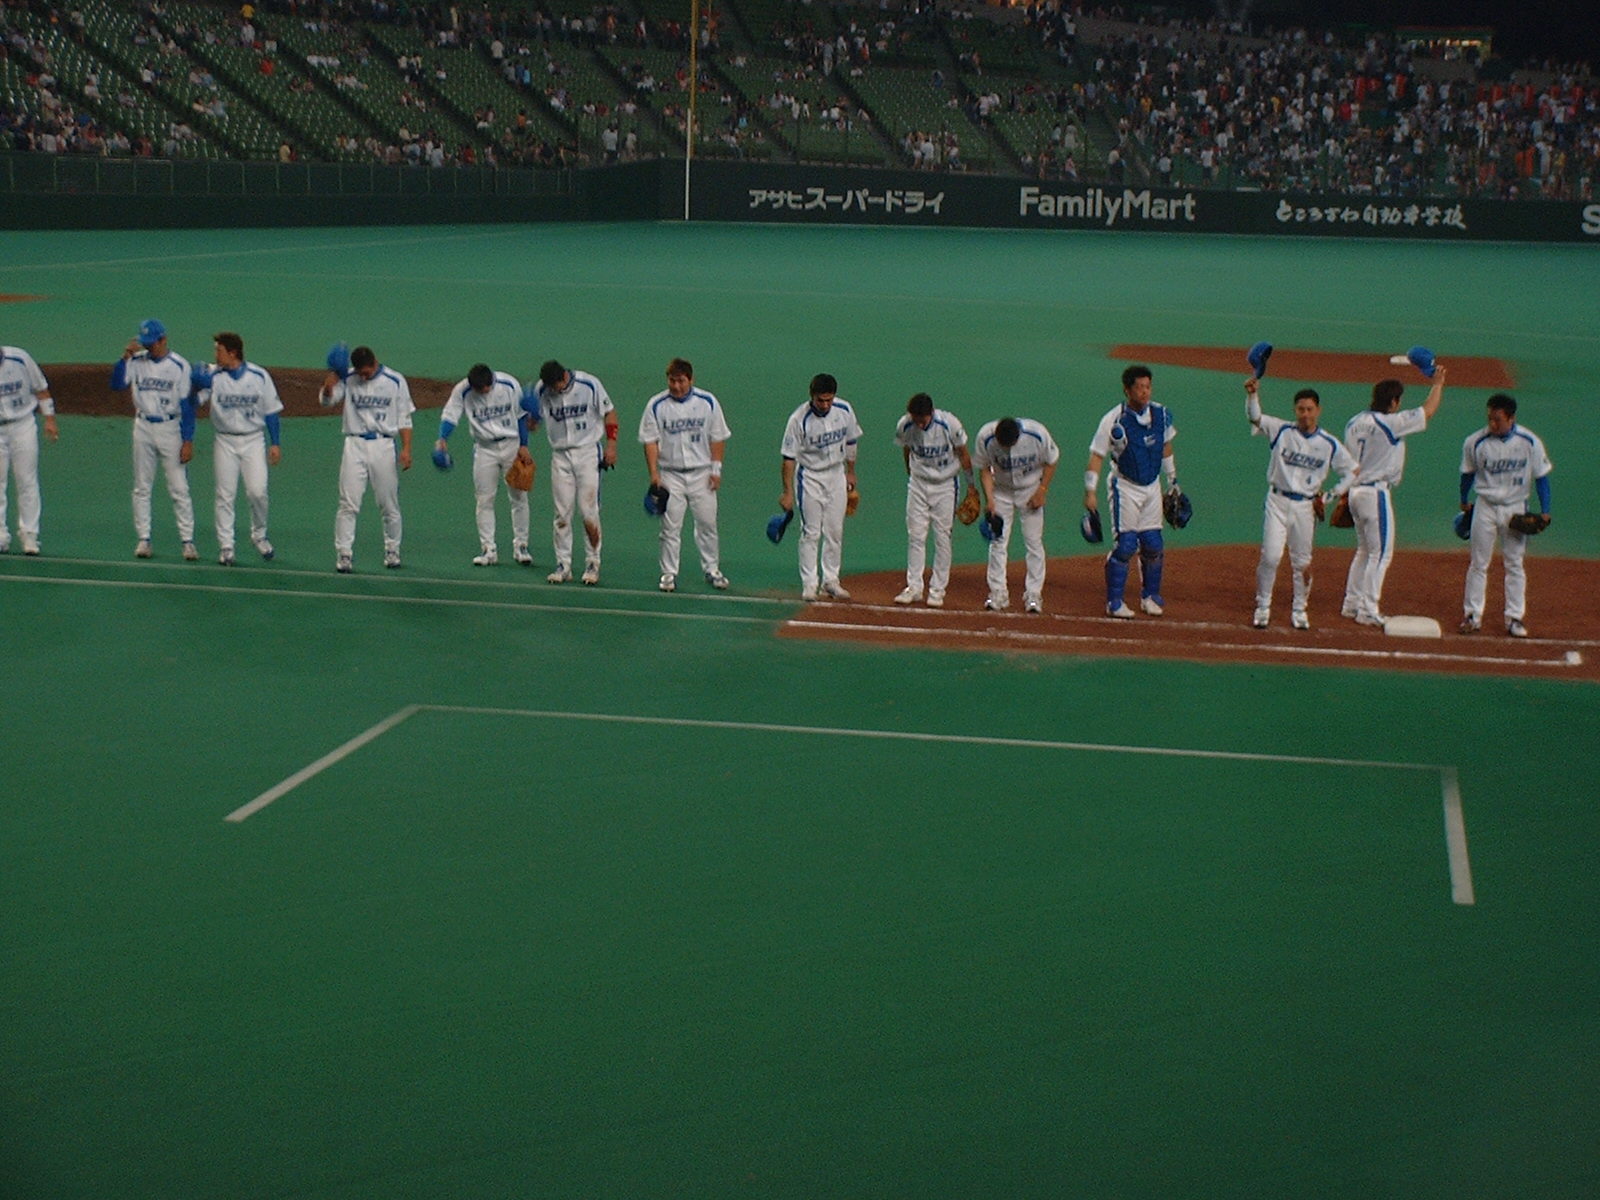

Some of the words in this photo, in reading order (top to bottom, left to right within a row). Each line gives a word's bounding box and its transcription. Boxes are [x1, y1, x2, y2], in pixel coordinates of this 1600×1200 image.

[748, 187, 946, 215] アサヒスーパードライ
[1020, 186, 1196, 226] FamilyMart
[661, 417, 705, 431] LIONS
[809, 427, 847, 445] LIONS
[1281, 448, 1326, 469] LIONS
[1356, 437, 1367, 464] 7
[1482, 458, 1528, 472] LIONS
